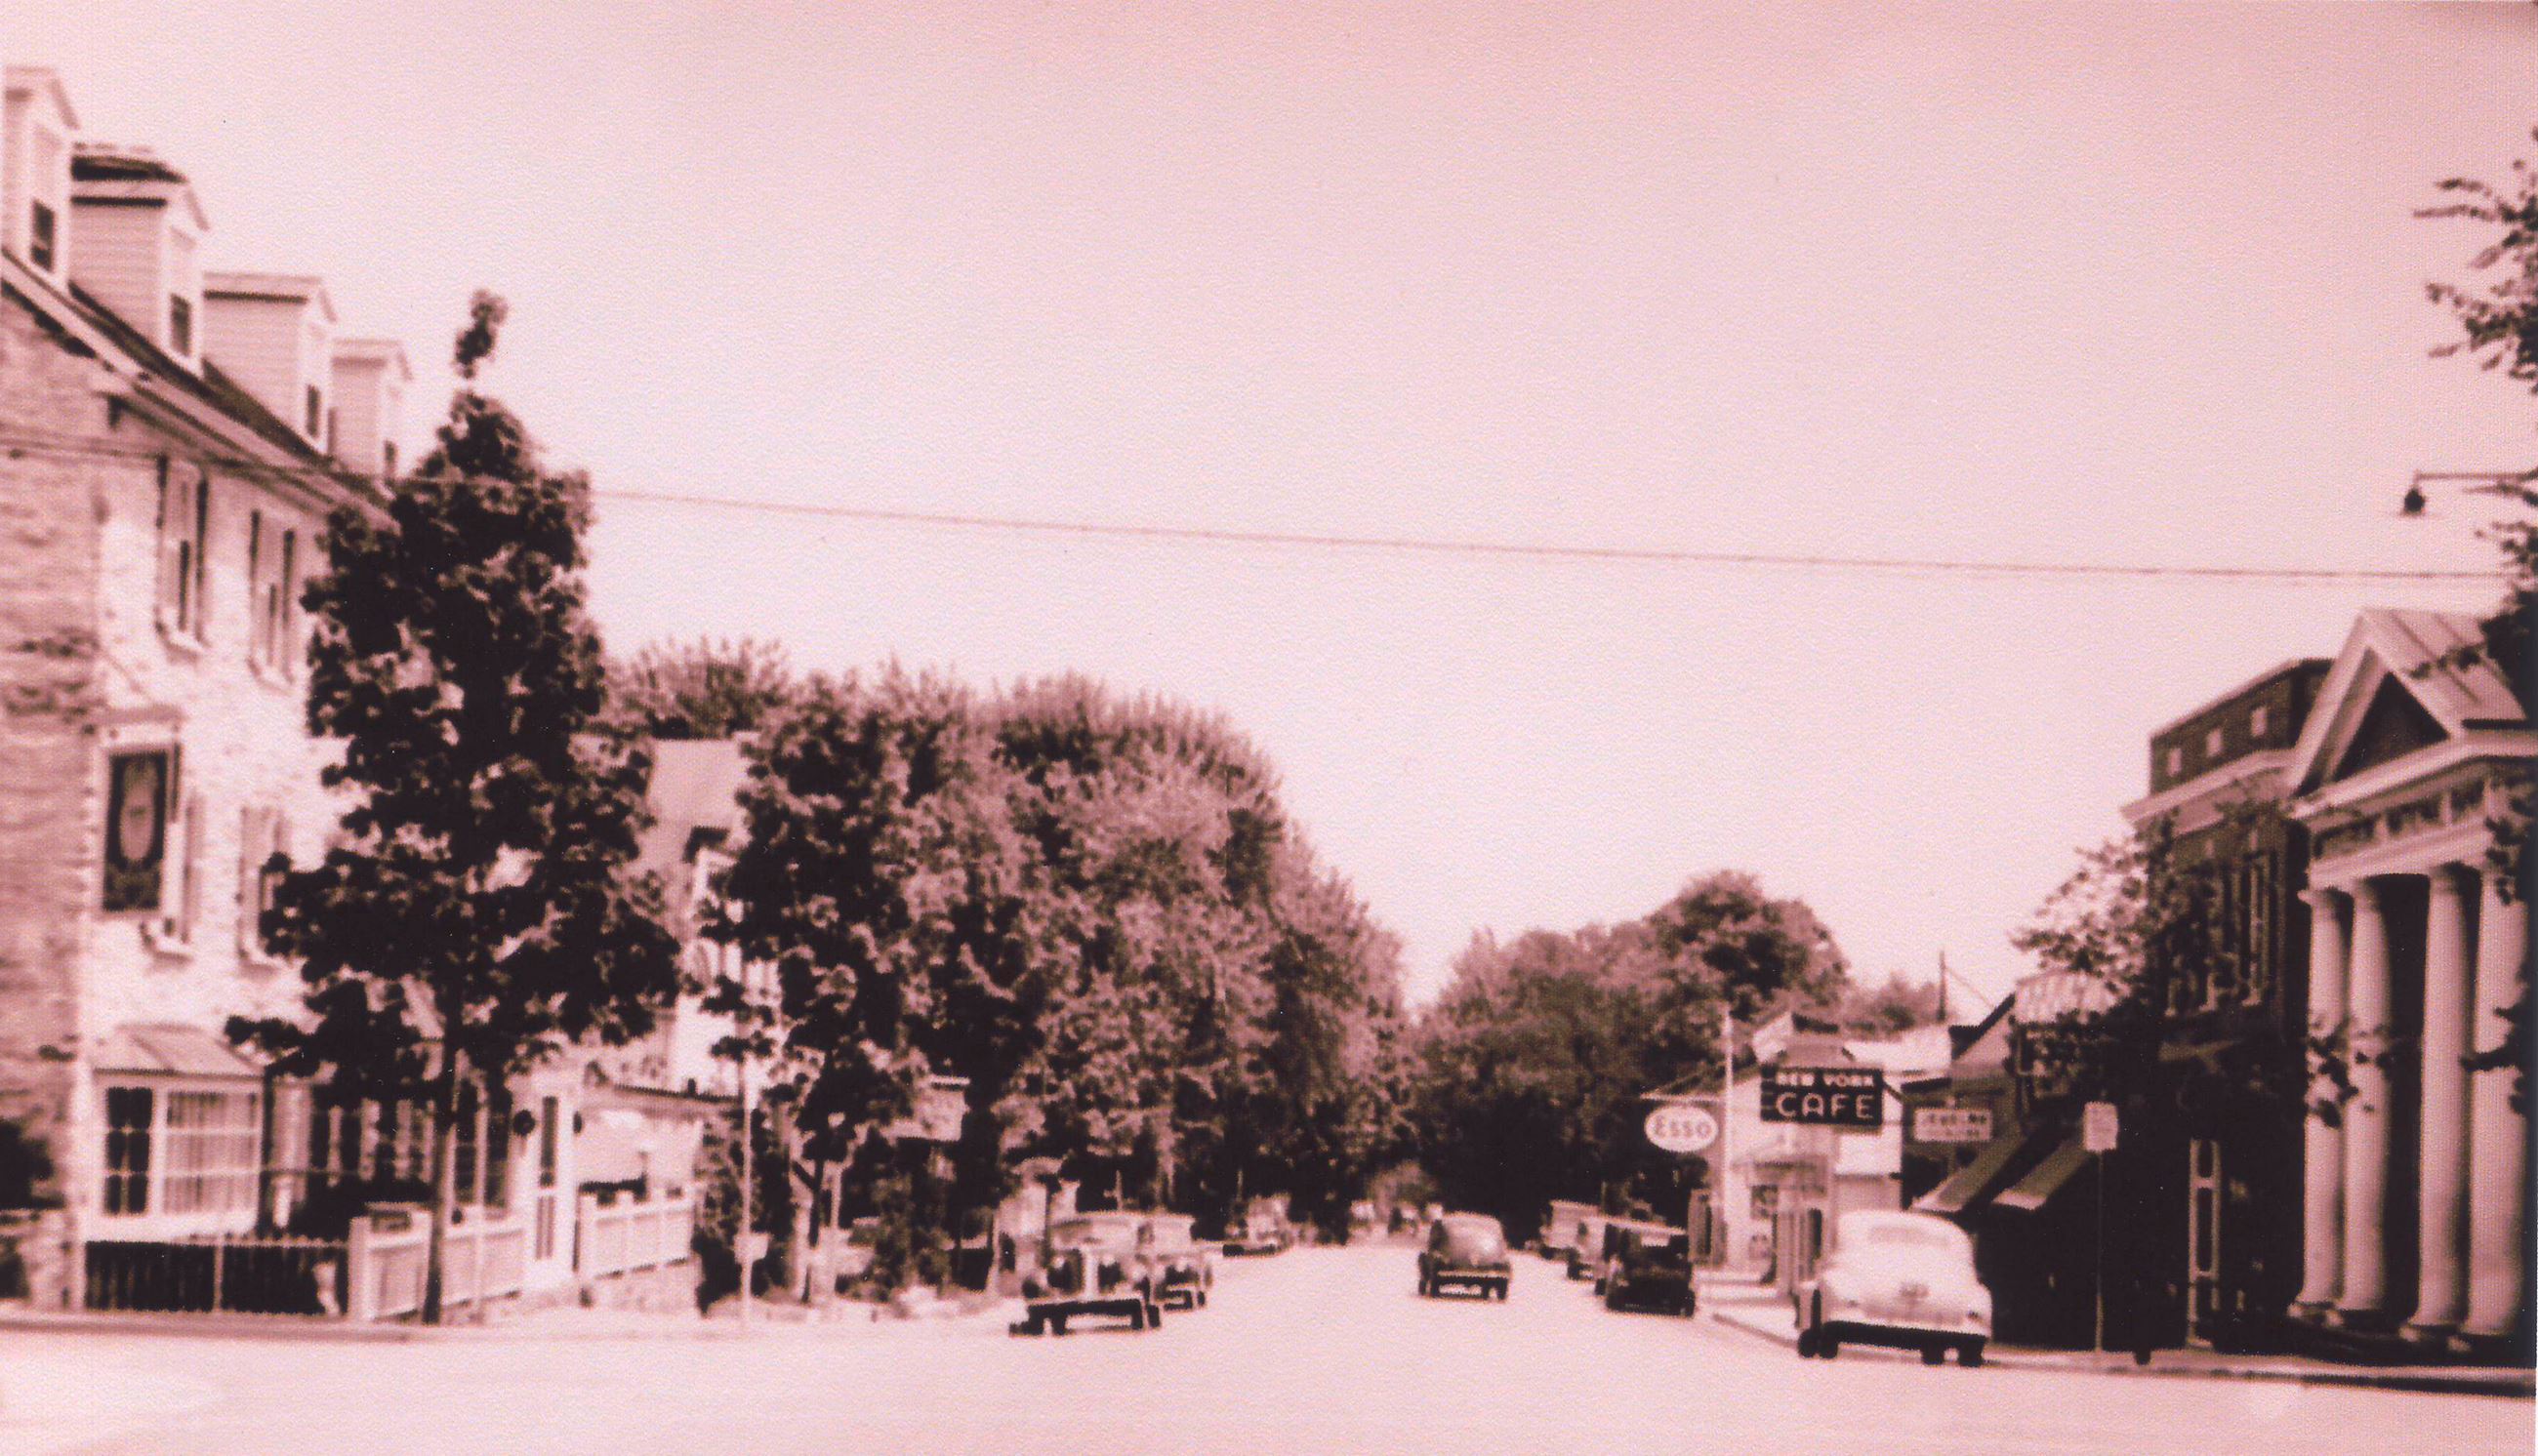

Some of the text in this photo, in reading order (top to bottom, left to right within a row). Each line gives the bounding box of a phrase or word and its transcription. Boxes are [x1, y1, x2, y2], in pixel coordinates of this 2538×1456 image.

[1776, 1072, 1874, 1087] NEW YORK
[1776, 1092, 1873, 1118] CAFE
